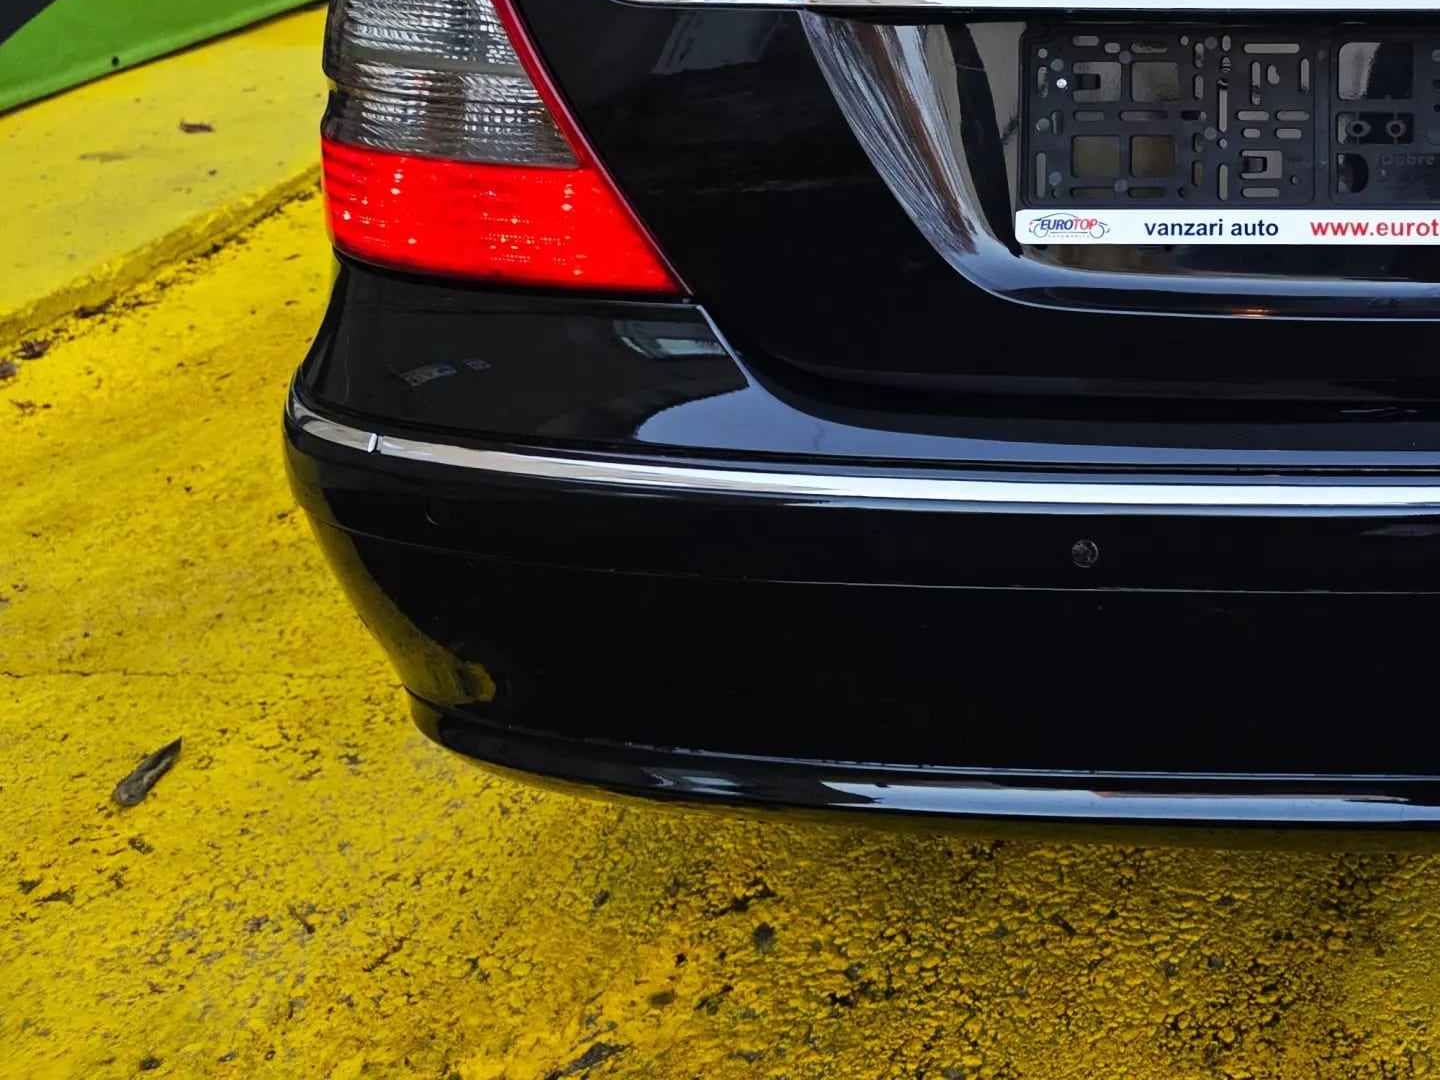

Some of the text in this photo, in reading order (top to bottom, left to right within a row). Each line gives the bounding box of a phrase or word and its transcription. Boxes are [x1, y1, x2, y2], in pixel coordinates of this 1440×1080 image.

[1040, 218, 1099, 231] EUROTOP
[1144, 219, 1224, 237] vanzari
[1231, 220, 1280, 237] auto
